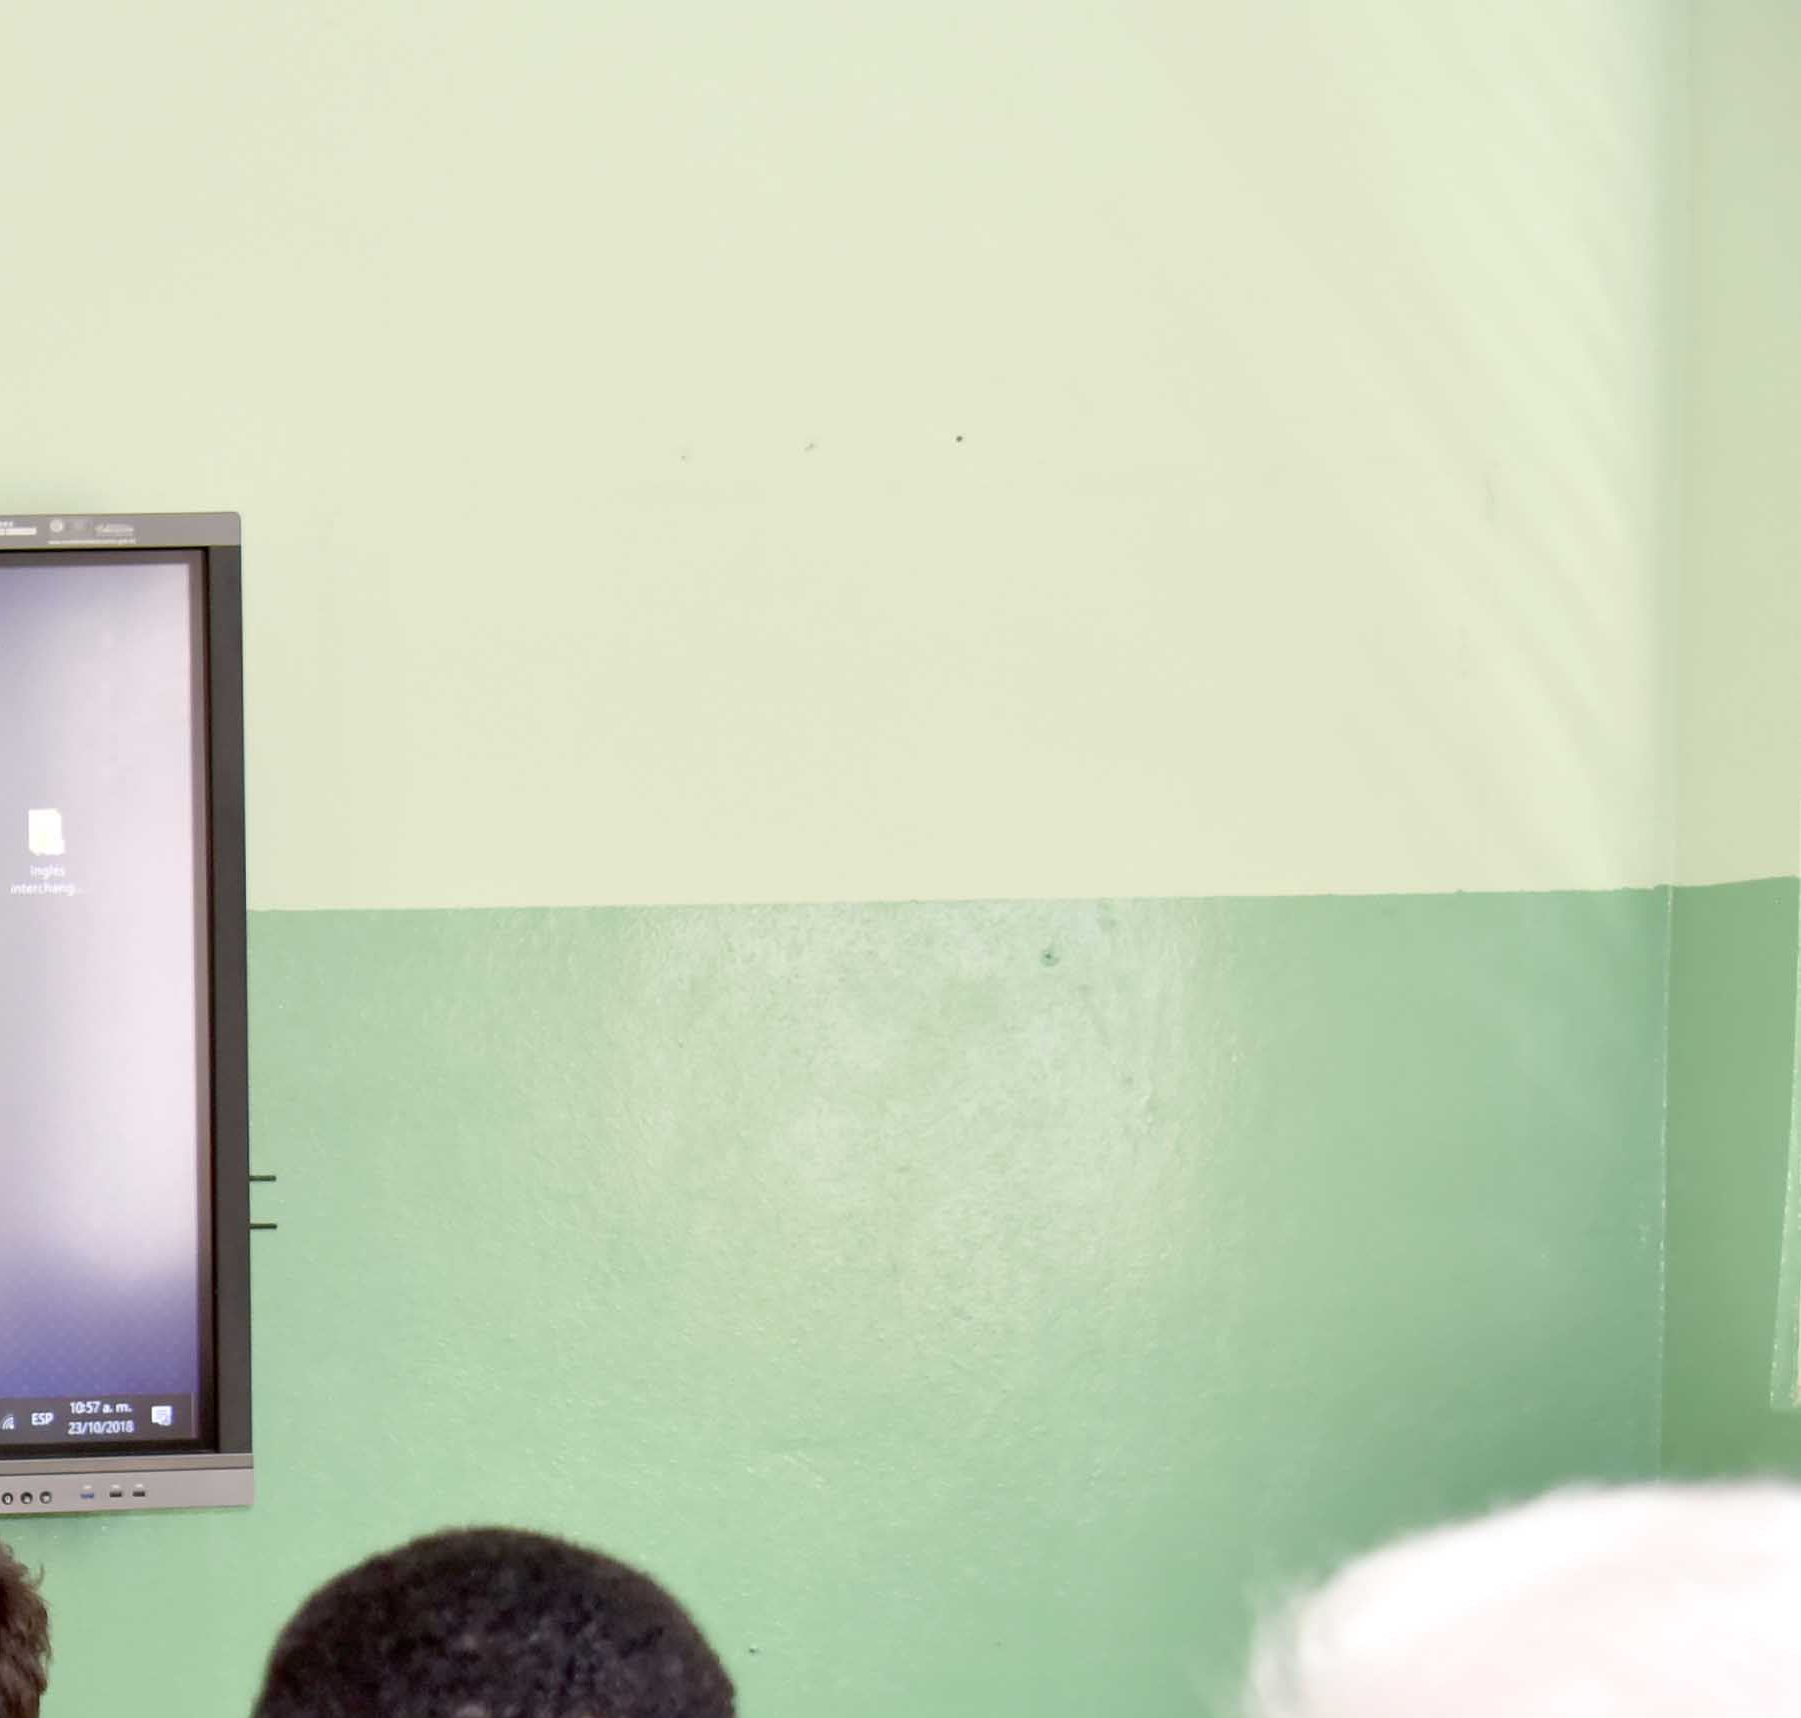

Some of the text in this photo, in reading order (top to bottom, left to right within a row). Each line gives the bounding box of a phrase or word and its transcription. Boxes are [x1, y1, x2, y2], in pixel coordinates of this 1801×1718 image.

[69, 1401, 101, 1414] 10:57
[31, 1412, 54, 1426] ESP
[67, 1420, 135, 1436] 23/10/2018
